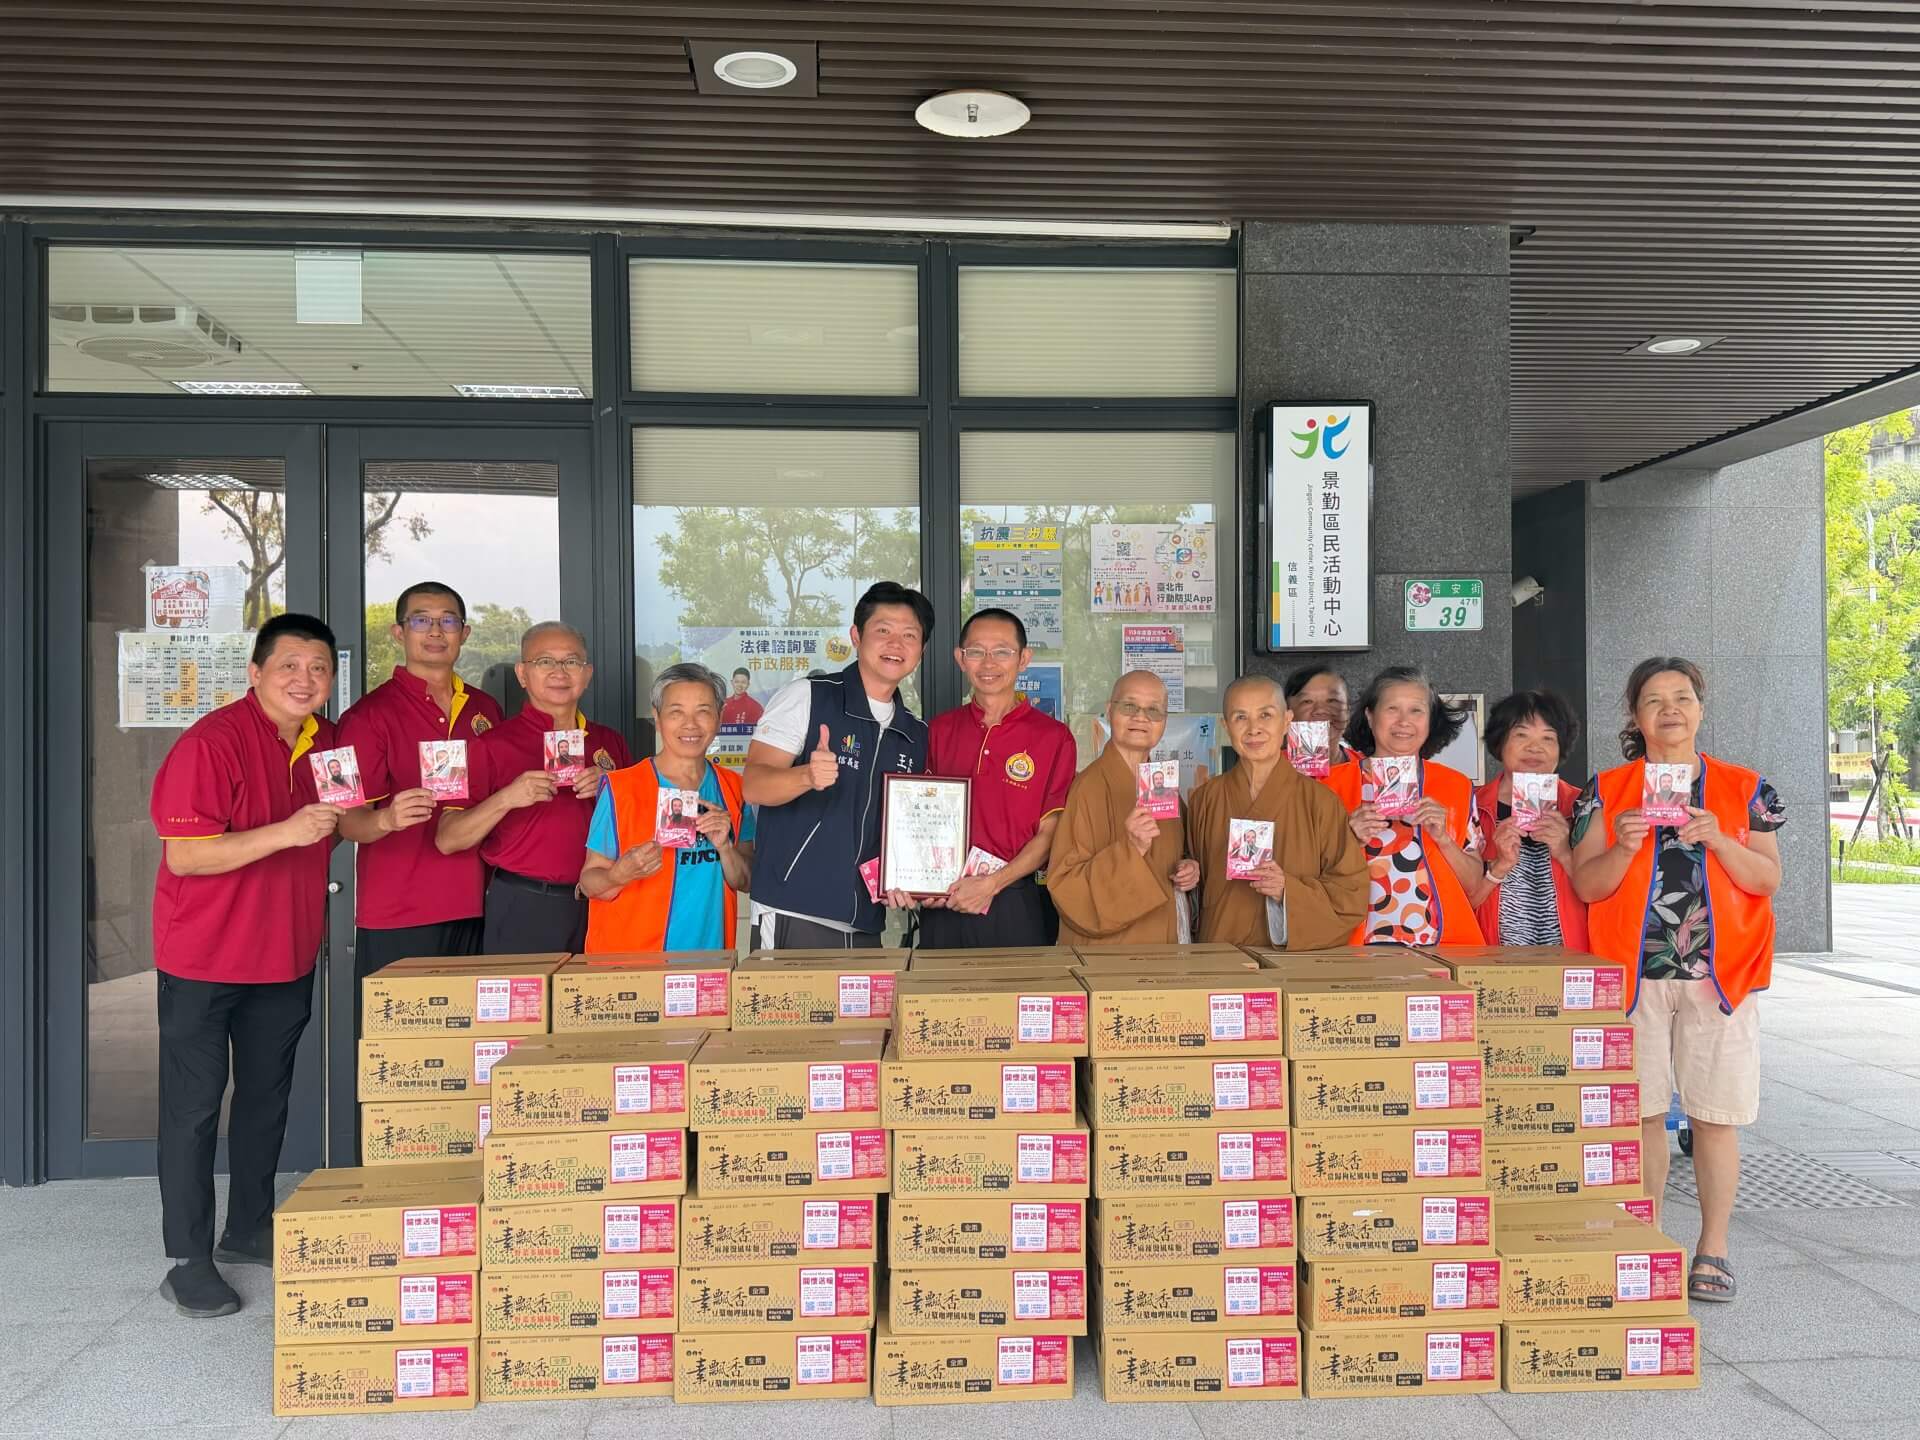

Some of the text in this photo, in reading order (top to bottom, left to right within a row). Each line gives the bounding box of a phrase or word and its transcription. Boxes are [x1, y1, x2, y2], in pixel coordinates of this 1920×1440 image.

[1306, 507, 1314, 542] Community
[1322, 471, 1341, 636] 景勤區民活動中心
[1156, 582, 1184, 592] 臺北市
[1288, 562, 1298, 598] 信義區
[1156, 594, 1213, 604] 行動防災App
[1440, 606, 1467, 626] 39
[740, 639, 817, 654] 法律諮詢暨
[748, 656, 810, 671] 市政服務
[374, 998, 428, 1024] 素飄香
[564, 992, 618, 1018] 素飄香
[740, 992, 794, 1018] 素飄香
[908, 1016, 966, 1044] 素飄香
[1104, 1014, 1160, 1040] 素飄香
[1298, 1014, 1356, 1042] 素飄香
[368, 1058, 424, 1086] 素飄香
[502, 1088, 562, 1118] 素飄香
[700, 1086, 758, 1114] 素飄香
[892, 1084, 950, 1112] 素飄香
[1306, 1082, 1364, 1110] 素飄香
[1486, 1104, 1536, 1128] 素飄香
[374, 1124, 430, 1150] 素飄香
[708, 1152, 766, 1180] 素飄香
[1108, 1152, 1168, 1182] 素飄香
[1306, 1150, 1364, 1178] 素飄香
[1490, 1164, 1542, 1190] 素飄香
[494, 1226, 552, 1254] 素飄香
[694, 1222, 752, 1250] 素飄香
[902, 1224, 960, 1252] 素飄香
[1116, 1222, 1174, 1250] 素飄香
[1316, 1220, 1374, 1248] 素飄香
[286, 1234, 348, 1264] 素飄香
[690, 1286, 748, 1314] 素飄香
[902, 1288, 960, 1316] 素飄香
[1112, 1288, 1172, 1318] 素飄香
[1324, 1284, 1382, 1312] 素飄香
[1514, 1276, 1570, 1304] 素飄香
[286, 1298, 346, 1328] 素飄香
[492, 1292, 552, 1322] 素飄香
[490, 1356, 550, 1386] 素飄香
[686, 1356, 744, 1384] 素飄香
[886, 1358, 946, 1388] 素飄香
[1116, 1356, 1176, 1386] 素飄香
[1320, 1352, 1378, 1380] 素飄香
[1520, 1348, 1578, 1376] 素飄香
[286, 1370, 346, 1400] 素飄香
